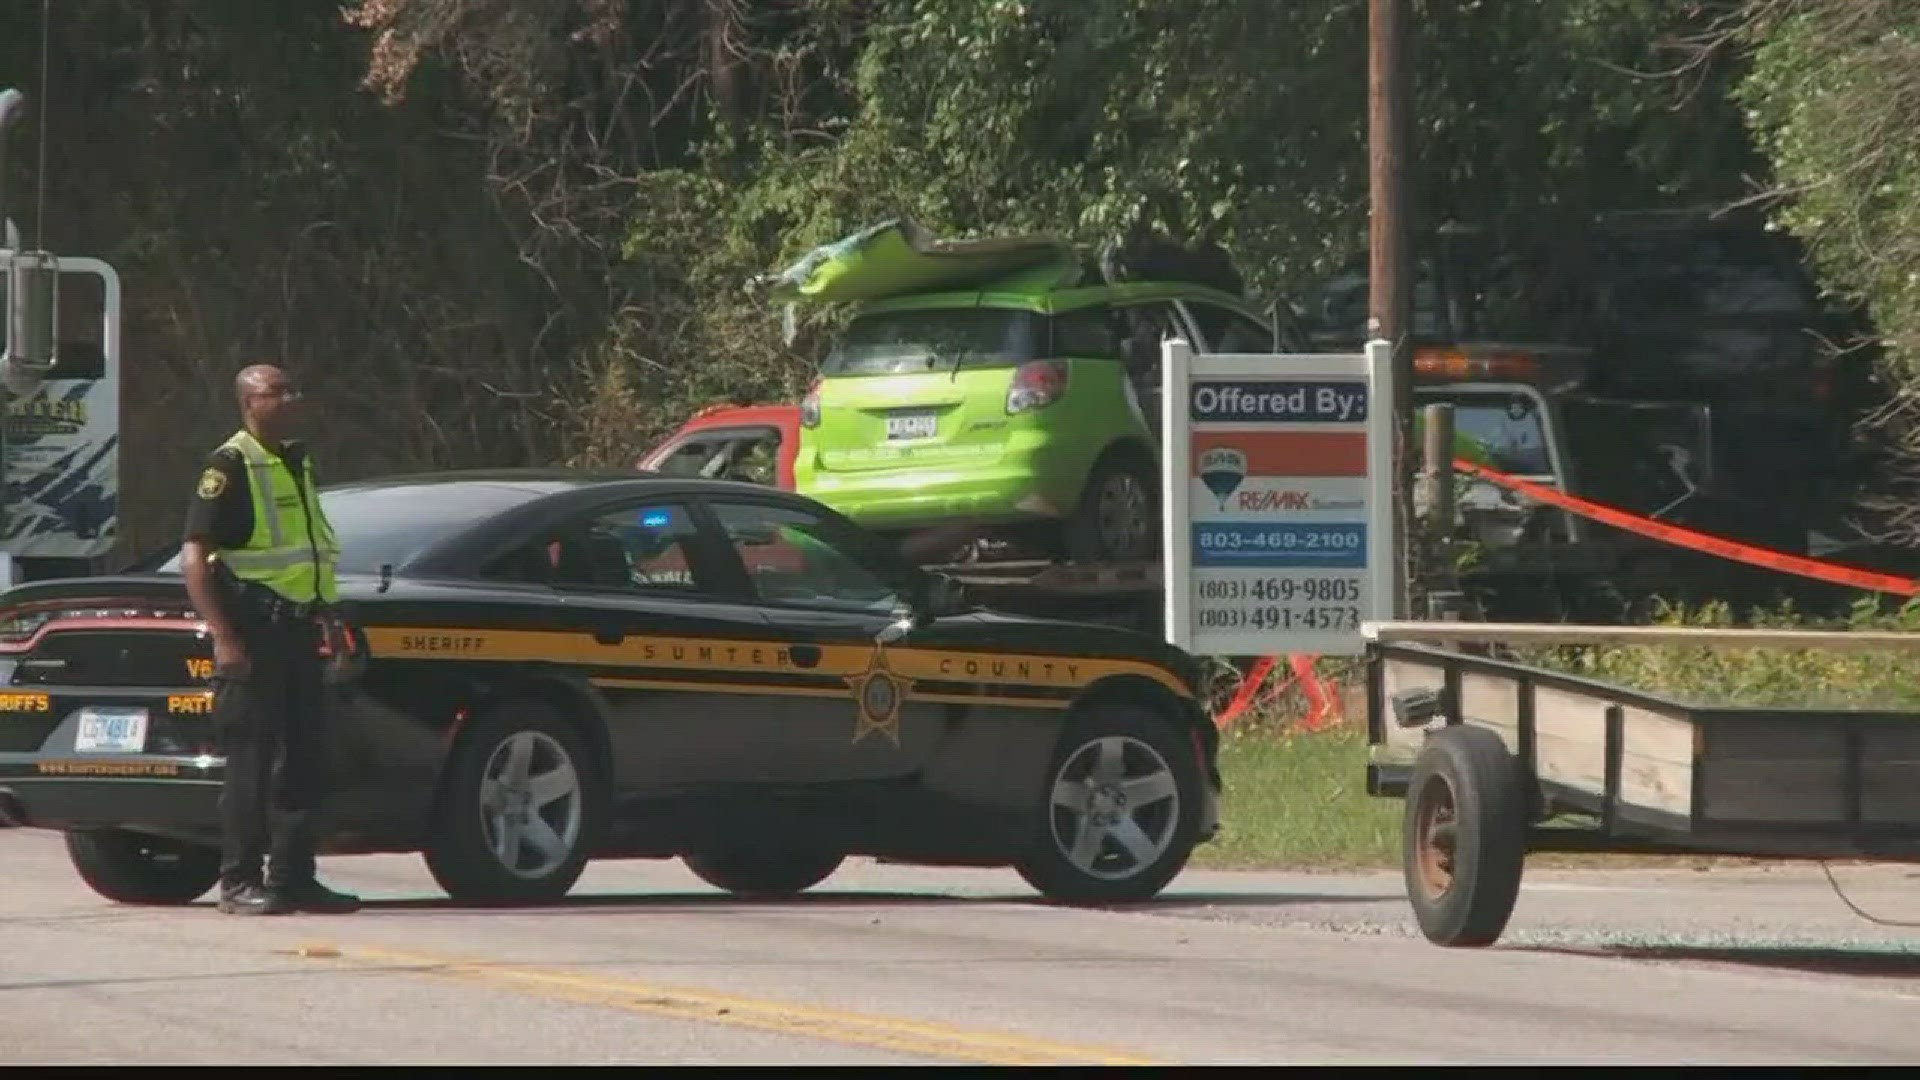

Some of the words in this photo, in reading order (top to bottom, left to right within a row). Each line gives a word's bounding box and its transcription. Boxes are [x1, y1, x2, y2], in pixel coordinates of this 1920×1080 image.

[1195, 388, 1305, 413] Offered
[1316, 388, 1365, 420] By:
[1200, 532, 1359, 549] 803-469-2100
[1199, 580, 1246, 598] (803)
[1250, 578, 1360, 601] 469-9805
[1199, 610, 1246, 627] (803)
[1251, 607, 1360, 630] 491-4573
[401, 636, 485, 652] SHERIFF
[643, 645, 790, 666] SUMTER
[939, 658, 1081, 682] COUNTY
